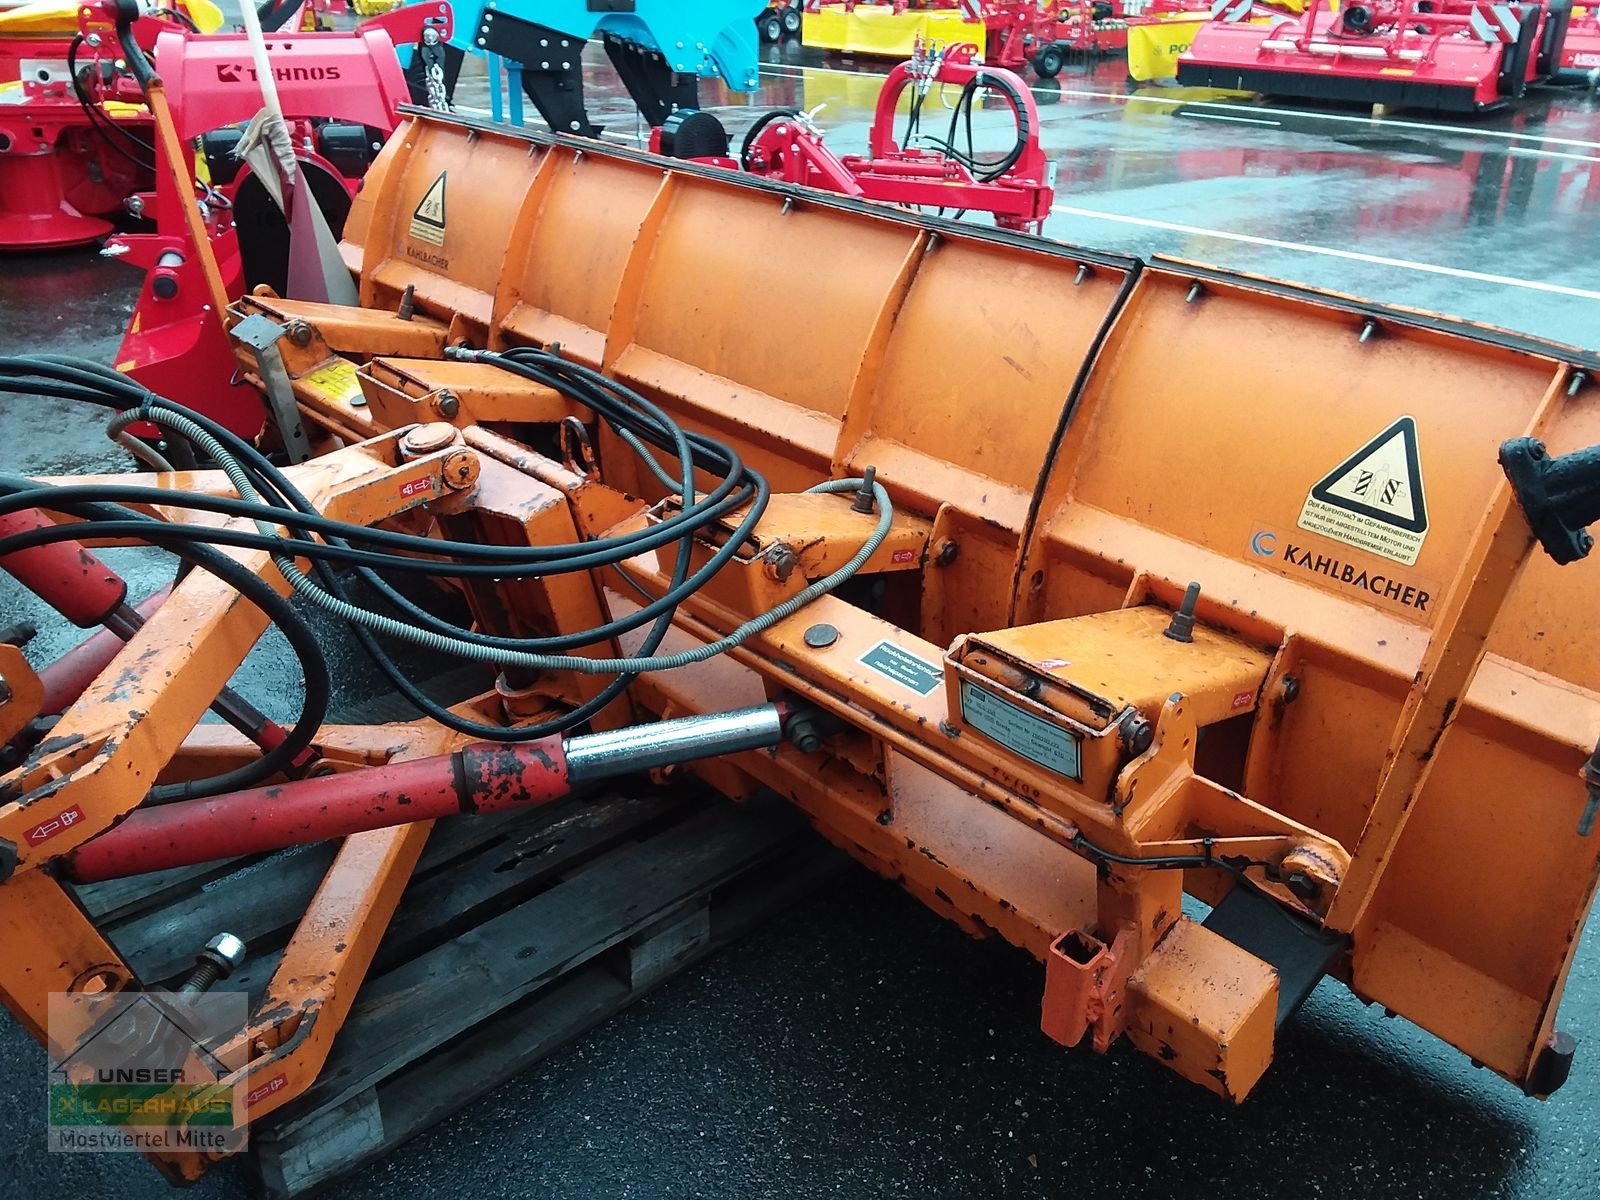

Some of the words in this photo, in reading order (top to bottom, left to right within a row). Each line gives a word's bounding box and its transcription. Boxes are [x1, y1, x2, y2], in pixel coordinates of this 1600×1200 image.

[1169, 43, 1191, 55] PO
[246, 66, 341, 82] THNOS
[1283, 543, 1431, 612] KAHLBACHER
